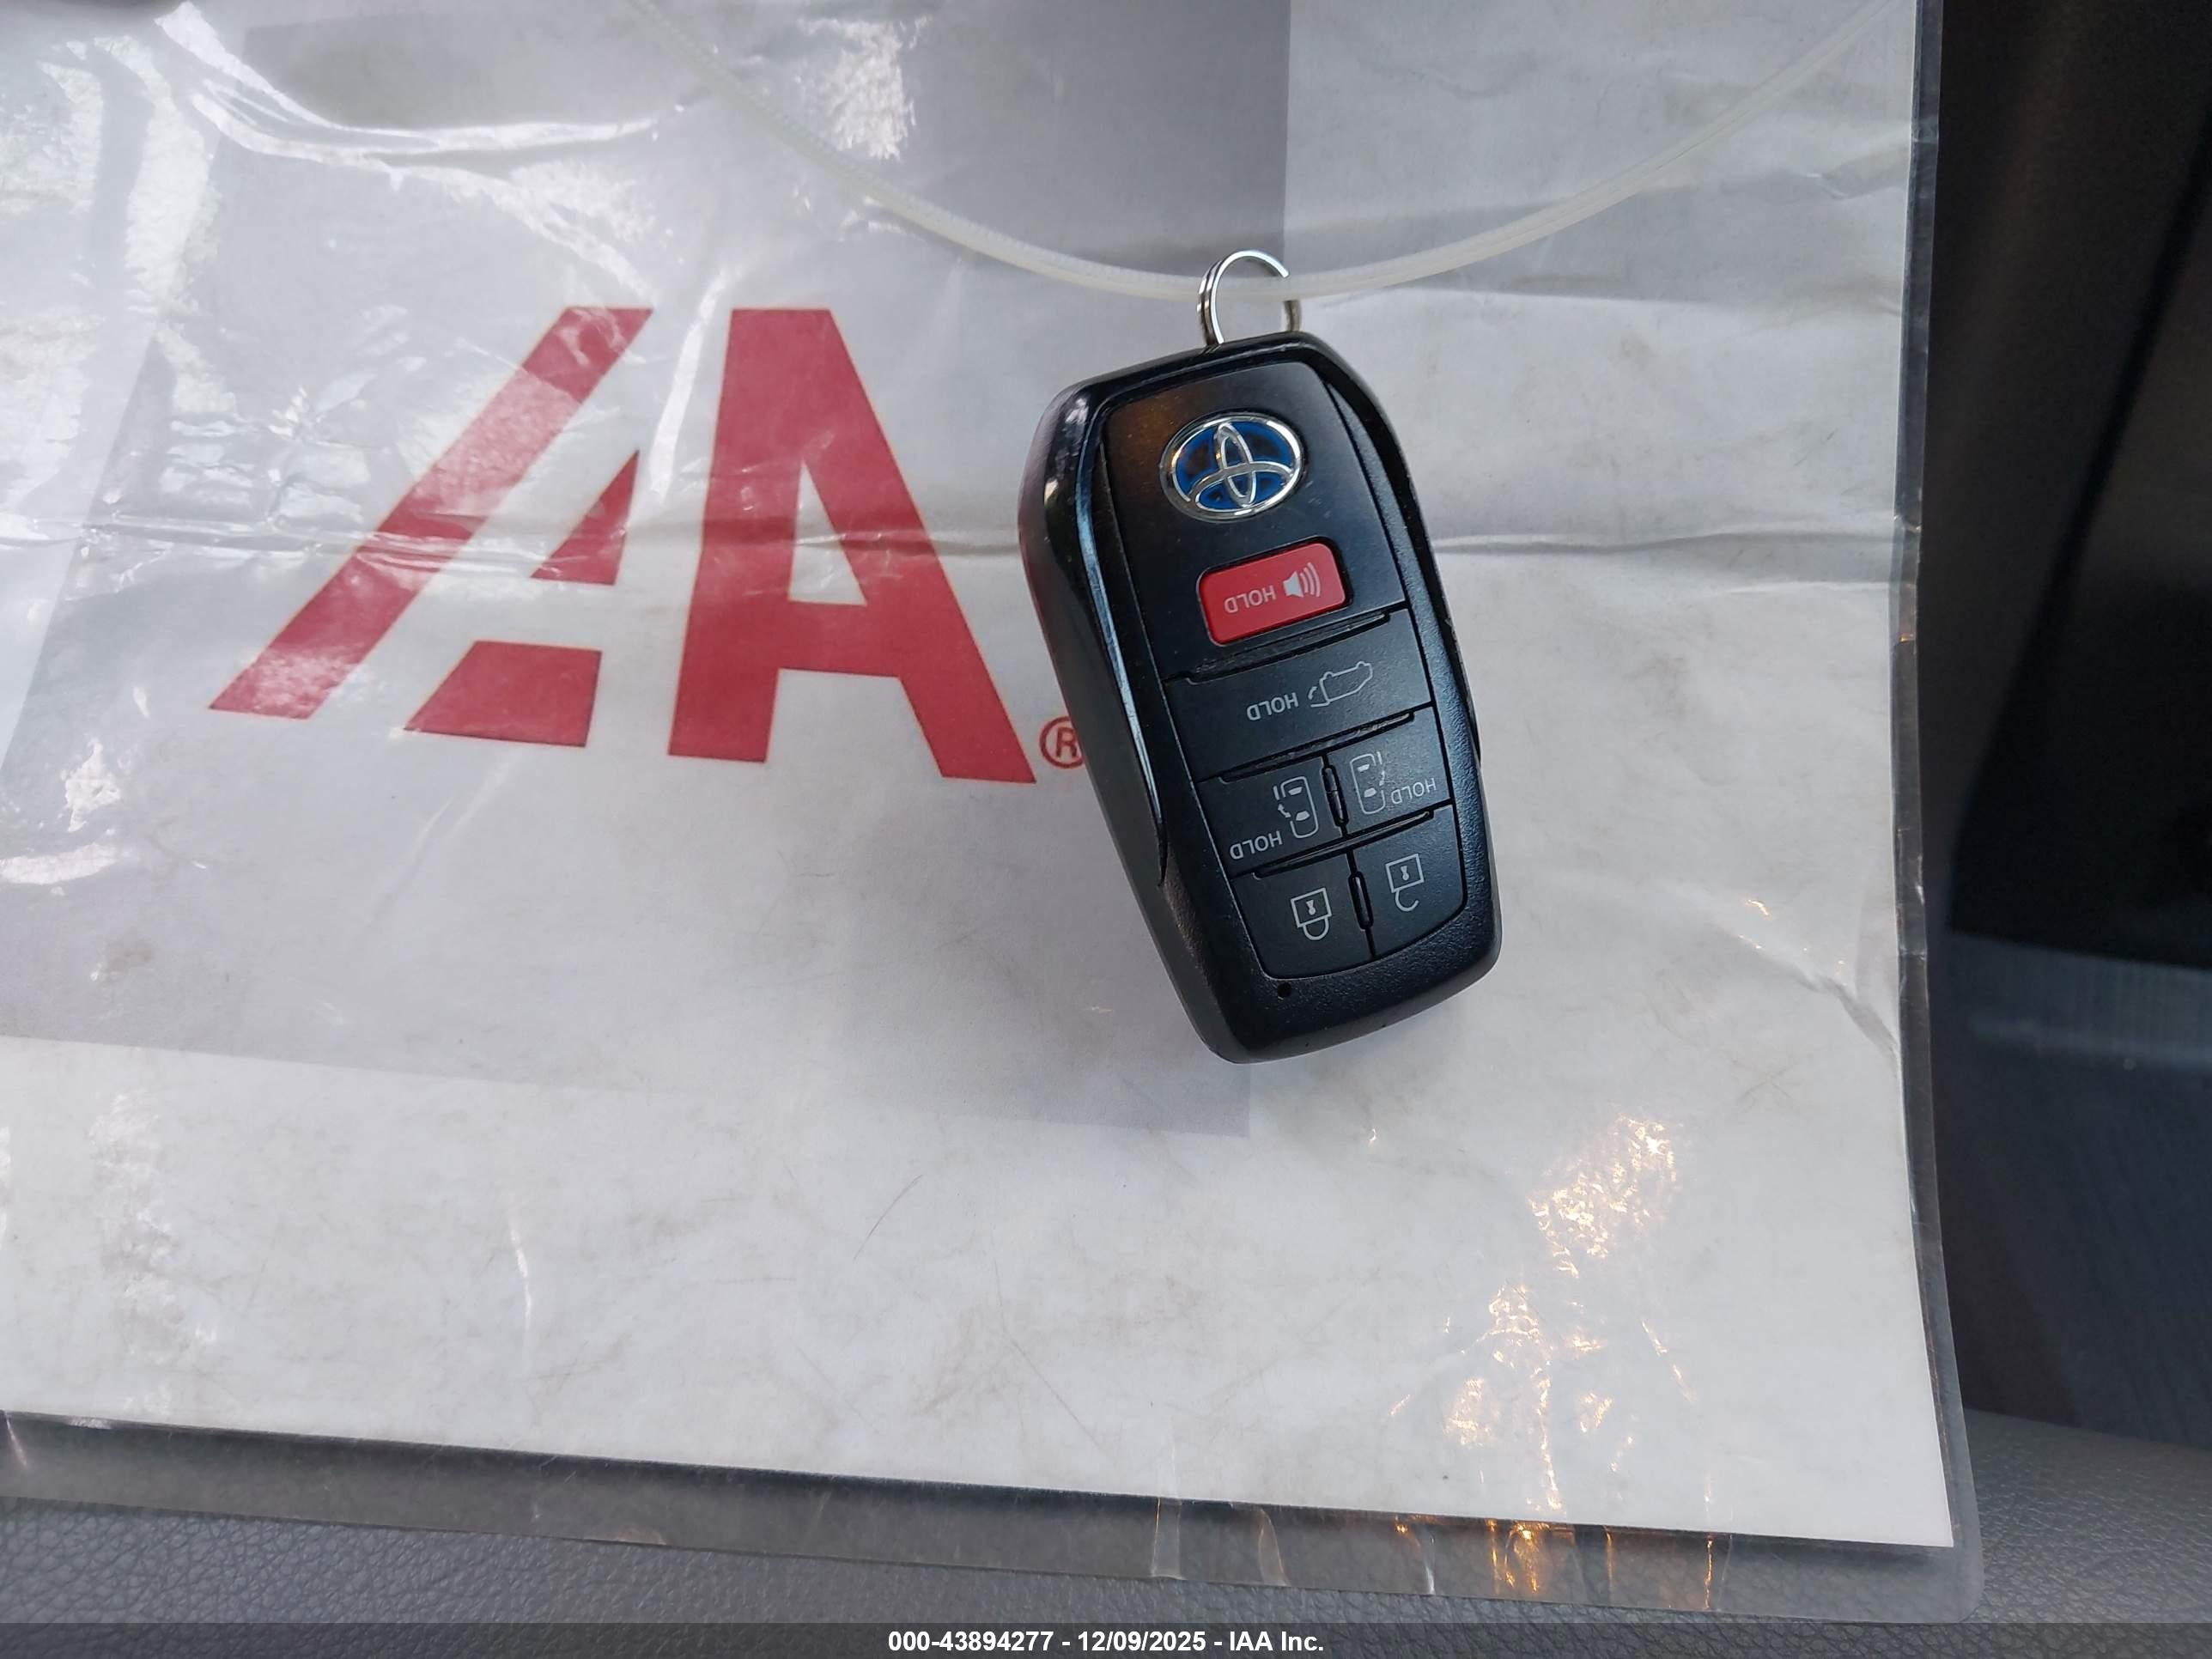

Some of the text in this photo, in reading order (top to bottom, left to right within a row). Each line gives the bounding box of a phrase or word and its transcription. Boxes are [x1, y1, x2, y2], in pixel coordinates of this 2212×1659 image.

[1224, 584, 1277, 613] HOLD
[1247, 692, 1299, 721] HOLD
[1390, 777, 1437, 805] HOLD
[1230, 830, 1283, 860] HOLD
